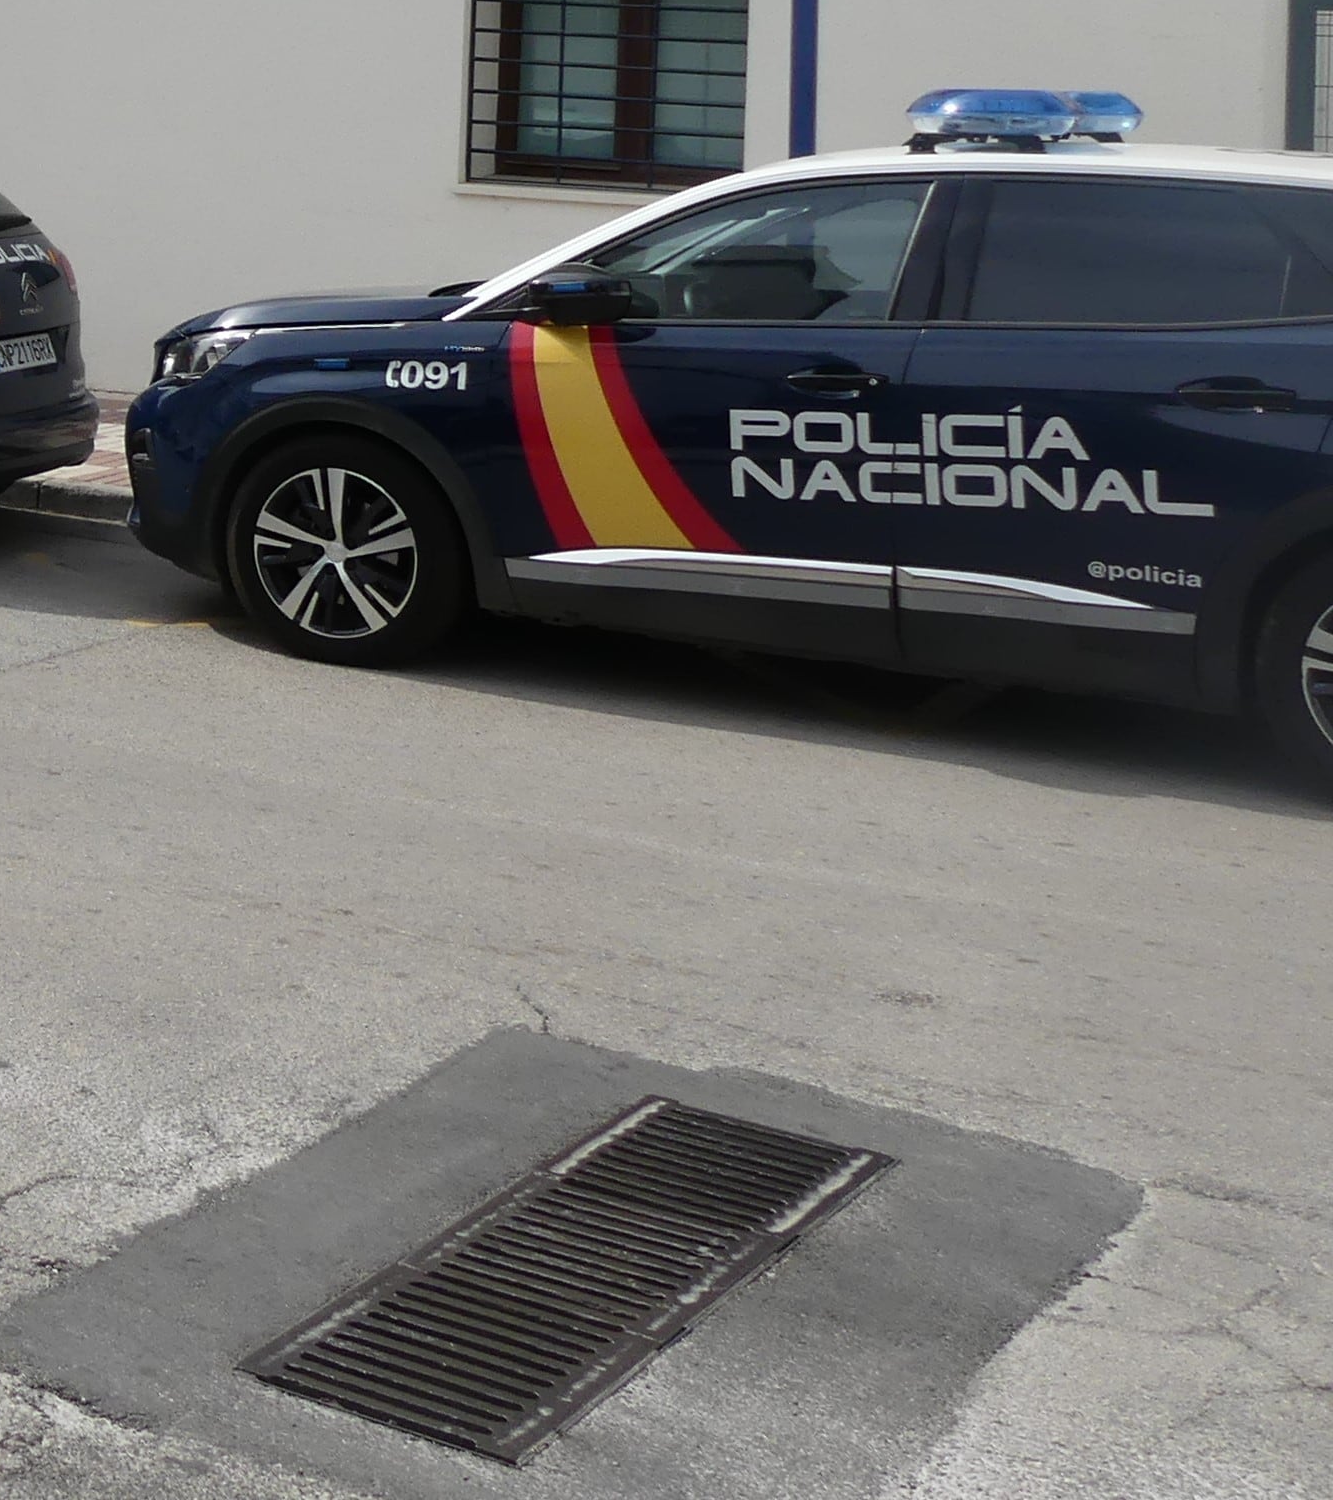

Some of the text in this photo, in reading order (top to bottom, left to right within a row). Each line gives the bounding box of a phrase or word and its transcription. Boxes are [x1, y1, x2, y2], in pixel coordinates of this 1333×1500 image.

[400, 360, 467, 390] 091
[729, 405, 1091, 461] POLICÍA
[731, 456, 1215, 517] NACIONAL
[1087, 560, 1203, 589] @policia
